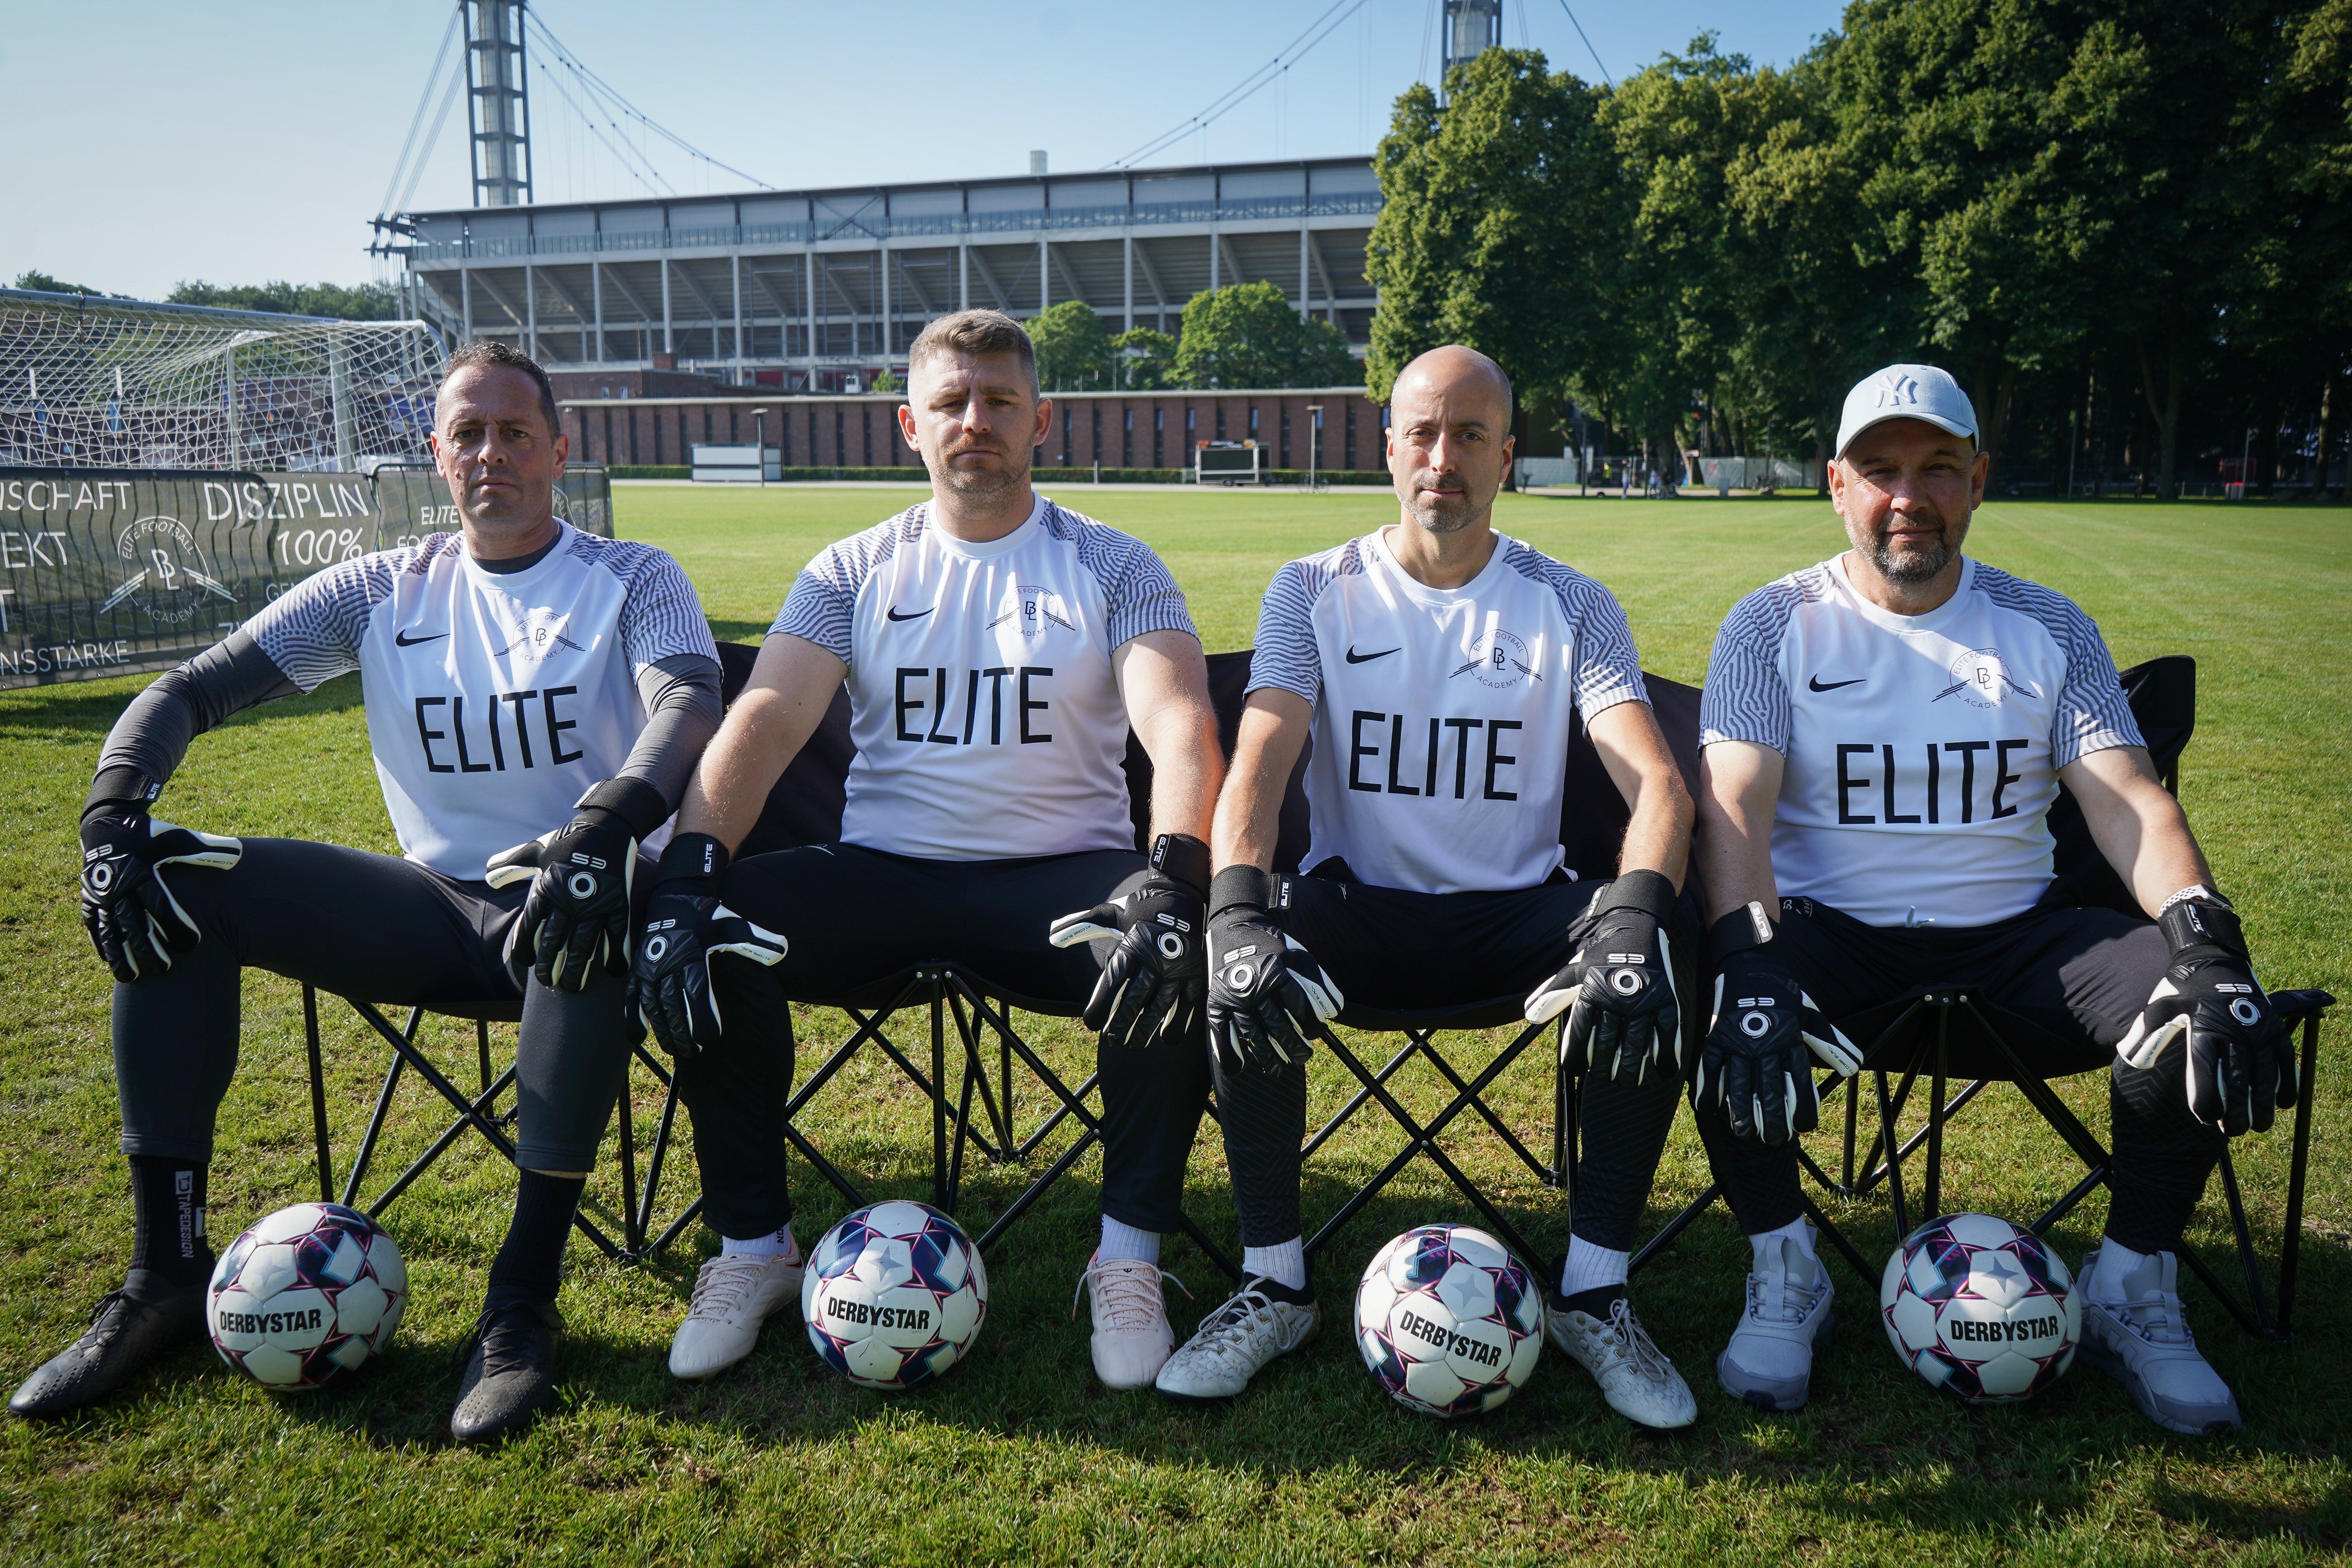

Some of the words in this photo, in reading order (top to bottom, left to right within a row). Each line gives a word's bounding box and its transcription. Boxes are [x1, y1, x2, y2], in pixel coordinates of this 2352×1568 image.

[0, 481, 131, 511] SCHAFT
[203, 482, 369, 521] DISZIPLIN
[421, 505, 459, 525] ELITE
[0, 531, 67, 568] EKT
[122, 527, 140, 559] ELITE
[141, 521, 194, 555] FOOTBALL
[277, 526, 363, 566] 100%
[143, 598, 199, 623] ACADEMY
[1011, 626, 1048, 636] ACADEMY
[1474, 636, 1490, 652] ELITE
[1491, 632, 1524, 654] FOOTBALL
[0, 639, 130, 676] NSSTÄRKE
[520, 649, 558, 662] ACADEMY
[1953, 657, 1969, 674] ELITE
[1476, 676, 1517, 688] ACADEMY
[895, 666, 1053, 745] ELITE
[1964, 693, 2007, 709] ACADEMY
[416, 685, 583, 773] ELITE
[1348, 710, 1523, 801] ELITE
[147, 782, 160, 799] ELITE
[1837, 739, 2029, 824] ELITE
[704, 843, 713, 873] ELITE
[1154, 836, 1167, 863] ELITE
[1280, 882, 1289, 906] ELITE
[1753, 906, 1769, 938] ELITE
[178, 1194, 194, 1258] TAPEDESIGN
[220, 1308, 321, 1334] DERBYSTAR
[828, 1297, 930, 1330] DERBYSTAR
[1950, 1315, 2059, 1342] DERBYSTAR
[1399, 1310, 1502, 1367] DERBYSTAR
